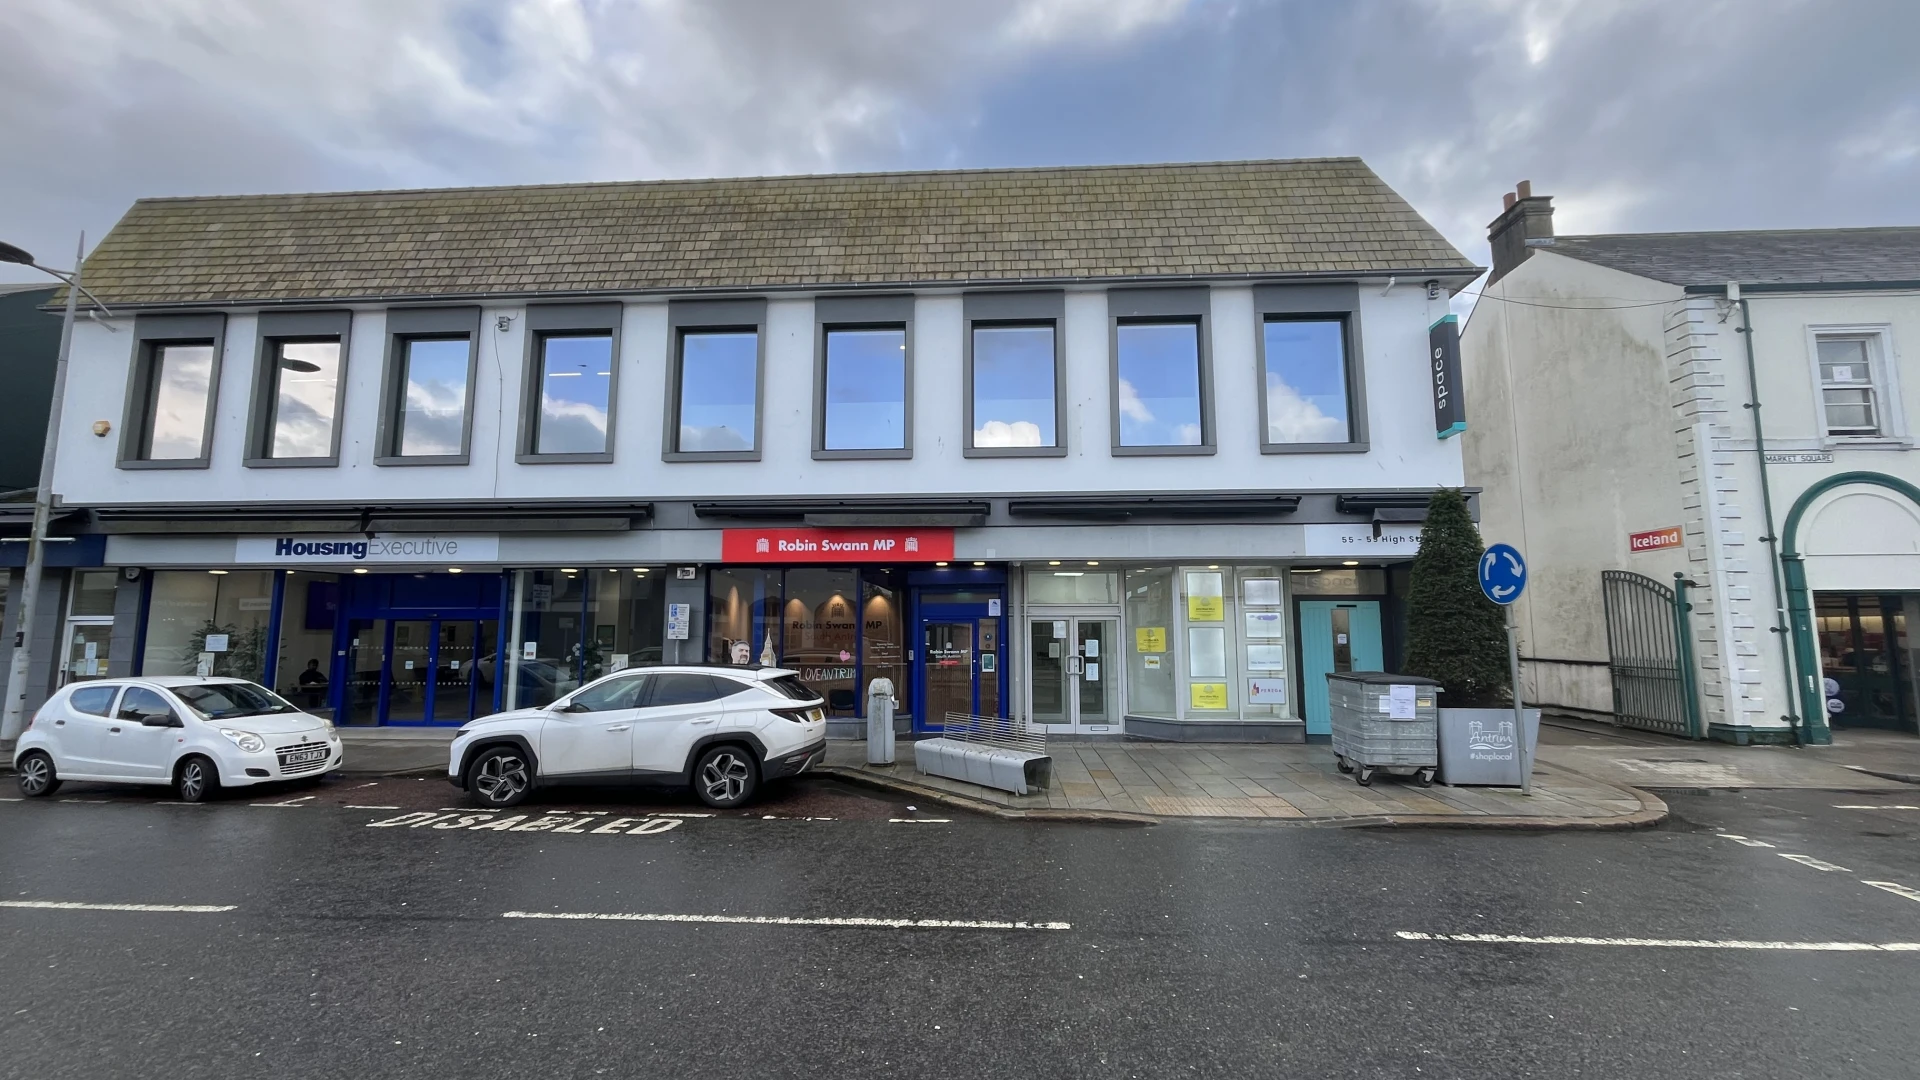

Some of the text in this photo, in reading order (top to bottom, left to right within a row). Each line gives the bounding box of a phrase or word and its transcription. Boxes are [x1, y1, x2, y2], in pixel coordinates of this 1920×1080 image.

[1435, 347, 1449, 410] space
[778, 539, 896, 552] Robin Swann MP
[1381, 535, 1406, 544] High
[1633, 531, 1678, 548] Iceland
[275, 536, 458, 560] Housing Executive
[792, 620, 882, 630] Robin Swan MP
[795, 667, 856, 682] LOVEANTRIM
[1470, 731, 1513, 744] Antrim
[290, 751, 324, 762] EN63 TJX
[1470, 752, 1513, 762] #shoplocal
[365, 811, 683, 834] DISABLED
